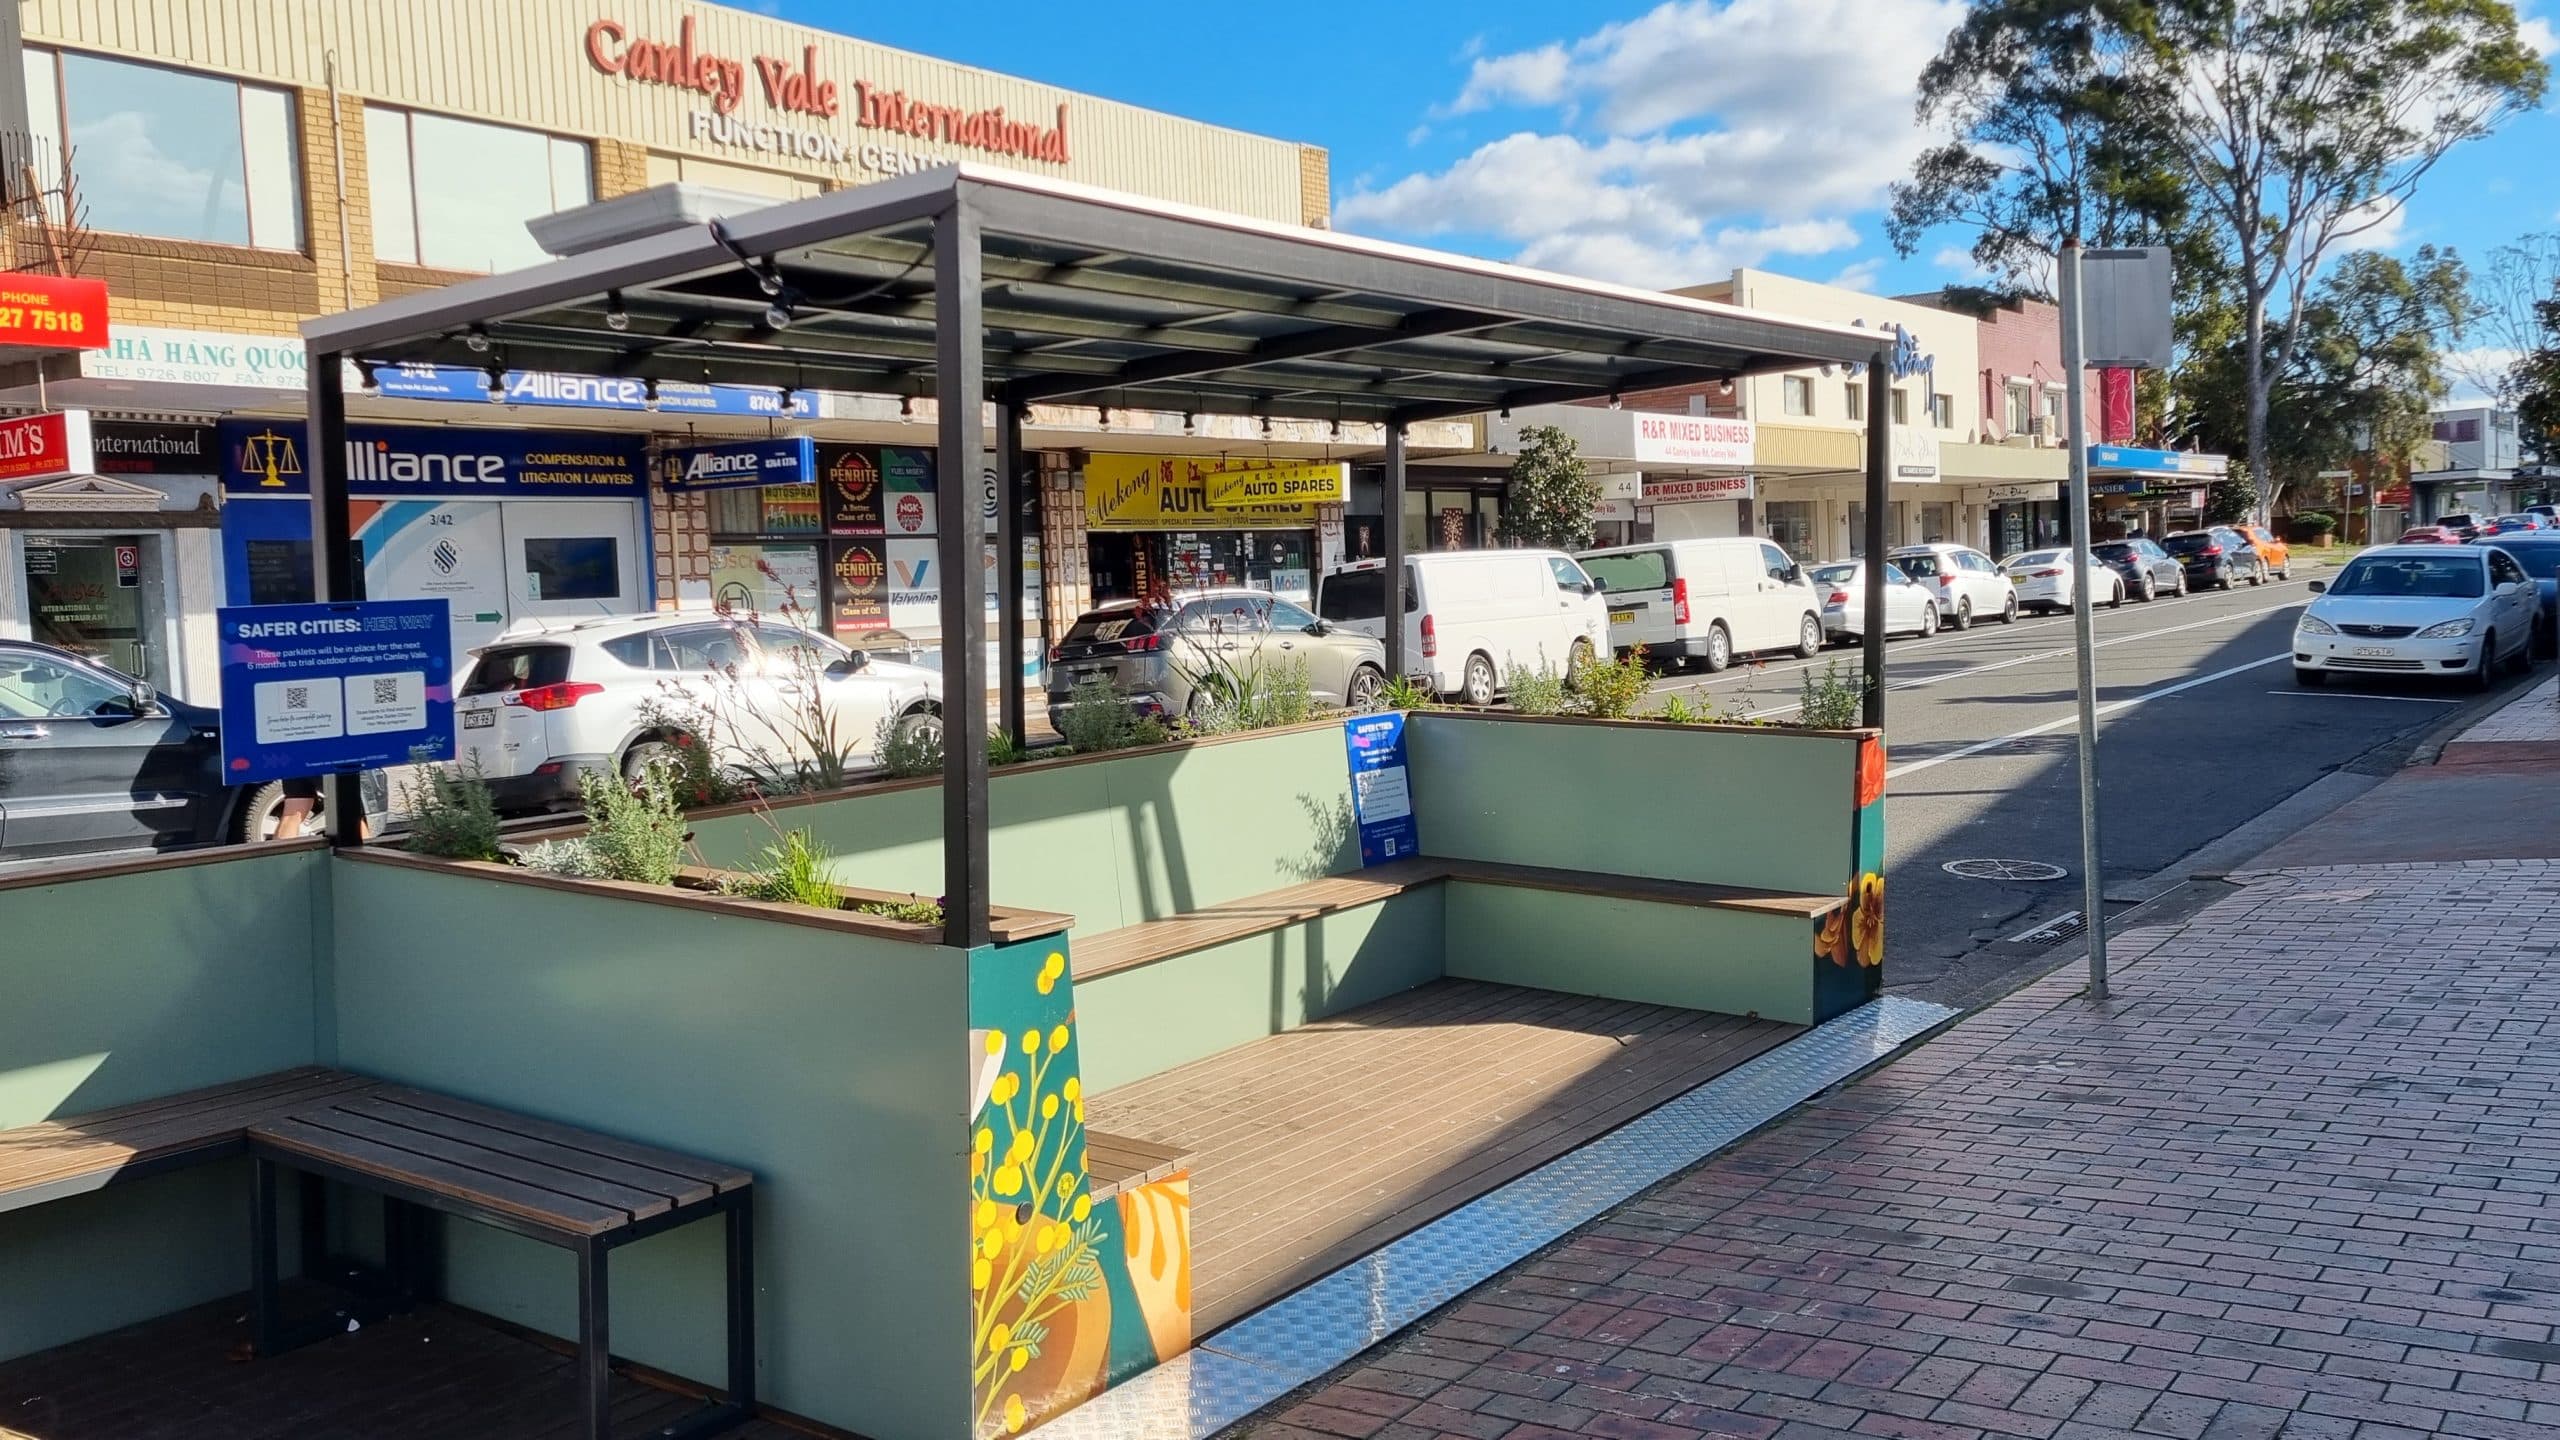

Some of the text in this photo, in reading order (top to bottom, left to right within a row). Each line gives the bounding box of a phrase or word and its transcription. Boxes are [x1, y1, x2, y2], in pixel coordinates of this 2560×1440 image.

[584, 16, 1071, 164] Canley Vale International
[689, 109, 955, 176] FUNCTION CENTR
[2, 292, 49, 306] PHONE
[0, 308, 84, 332] 27 7518
[164, 336, 237, 368] HÀNG
[95, 365, 129, 377] TEL:
[137, 367, 177, 381] 9726
[183, 371, 220, 384] 8007
[234, 372, 267, 385] FAX:
[511, 372, 638, 404] Alliance
[750, 395, 778, 411] 8764
[1642, 420, 1749, 443] R&R MIXED BUSINESS
[94, 430, 201, 455] nternational
[345, 441, 507, 483] lliance
[525, 453, 627, 467] COMPENSATION &
[685, 452, 758, 480] Alliance
[519, 471, 634, 485] LITIGATION LAWYERS
[829, 468, 879, 482] PENRITE
[1213, 475, 1245, 499] Mekong
[1244, 481, 1278, 497] AUTO
[1283, 478, 1335, 494] SPARES
[1617, 482, 1633, 493] 44
[1642, 478, 1746, 497] &R MIXED BUSINESS
[2090, 483, 2125, 494] NASIER
[1089, 467, 1151, 528] Mekong
[1160, 486, 1214, 513] AUT
[849, 503, 871, 511] Better
[900, 503, 920, 513] NGK
[430, 514, 454, 526] 3/42
[837, 513, 857, 521] Class
[711, 554, 759, 569] OSCH
[835, 562, 884, 577] PENRITE
[1134, 551, 1147, 596] PENRI
[1274, 574, 1305, 592] Mobil
[854, 598, 875, 606] Better
[890, 591, 938, 606] Valvoline
[54, 613, 108, 622] RESTAURANT
[841, 606, 881, 616] Class of Oil
[238, 622, 297, 638] SAFER
[300, 618, 362, 635] CITIES:
[363, 616, 398, 632] HER
[399, 614, 434, 630] WAY
[256, 640, 421, 659] These parklets will be in place for the next
[247, 662, 254, 670] 6
[255, 660, 287, 669] months
[288, 660, 297, 668] to
[298, 657, 315, 667] trial
[317, 656, 348, 666] outdoor
[349, 654, 374, 665] dining
[374, 653, 382, 662] in
[383, 652, 409, 663] Canley
